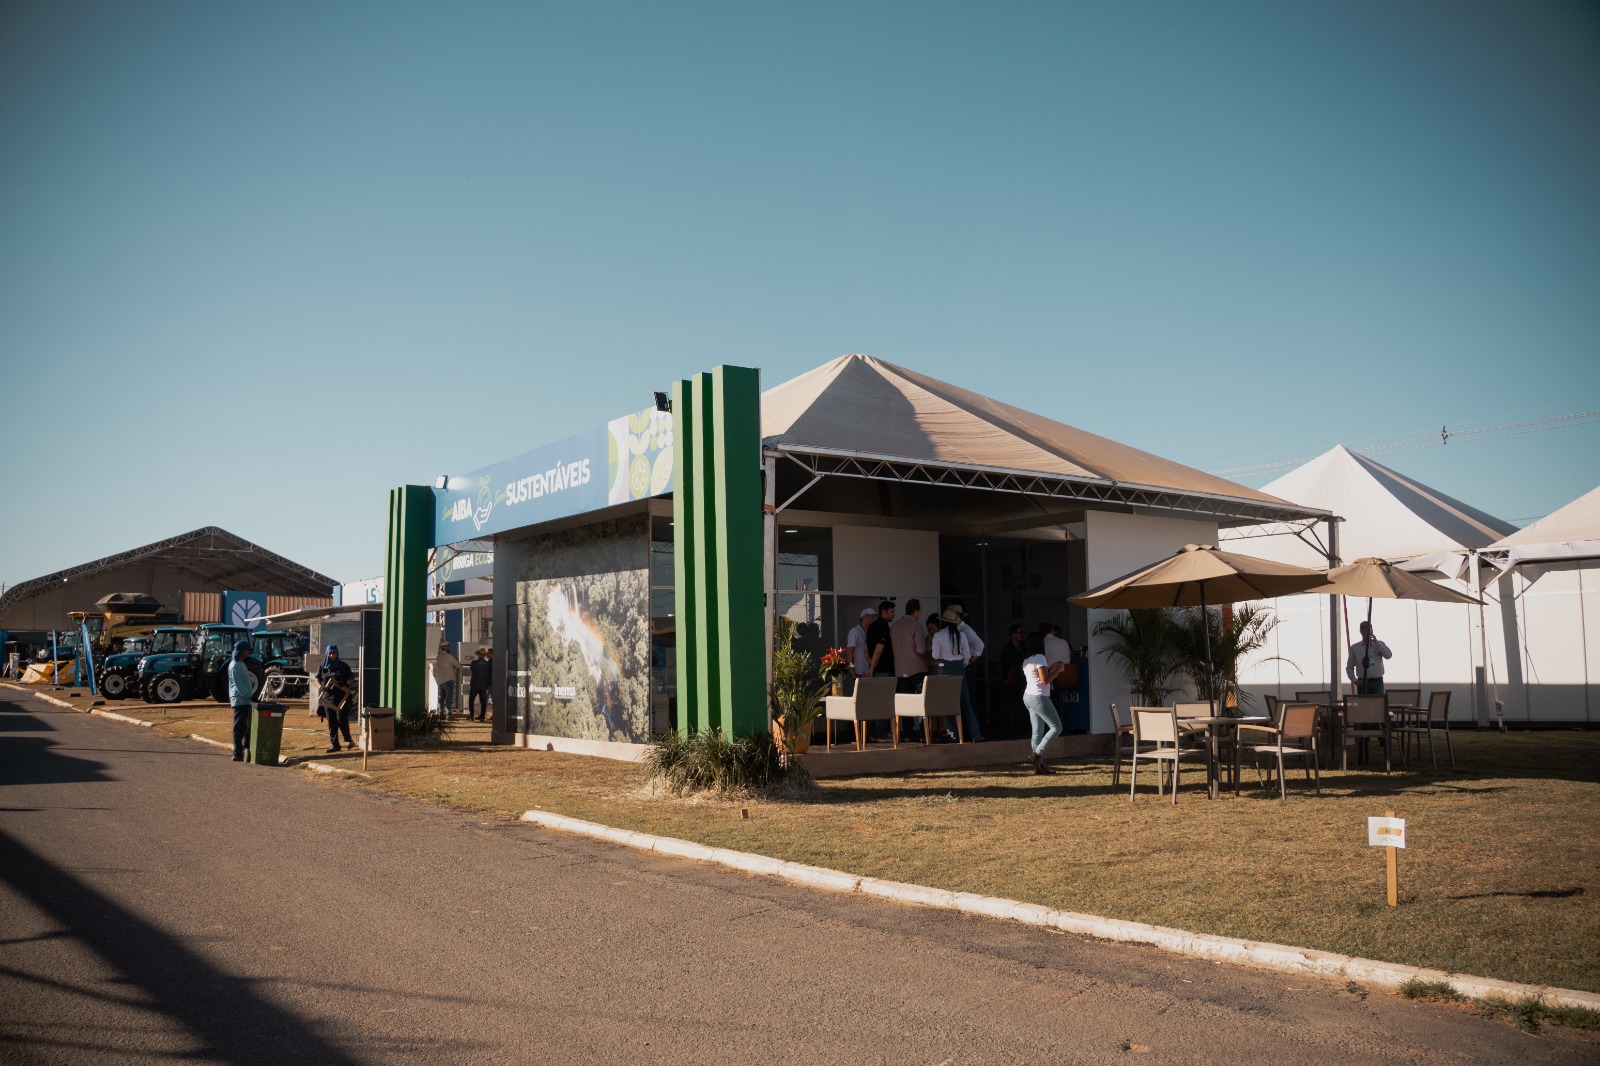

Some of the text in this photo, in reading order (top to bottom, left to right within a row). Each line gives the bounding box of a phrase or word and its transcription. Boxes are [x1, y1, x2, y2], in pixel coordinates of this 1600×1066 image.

[452, 497, 472, 522] AIBA
[506, 458, 591, 506] SUSTENTÁVEIS
[453, 553, 474, 570] IRRIGA
[366, 587, 376, 604] LS
